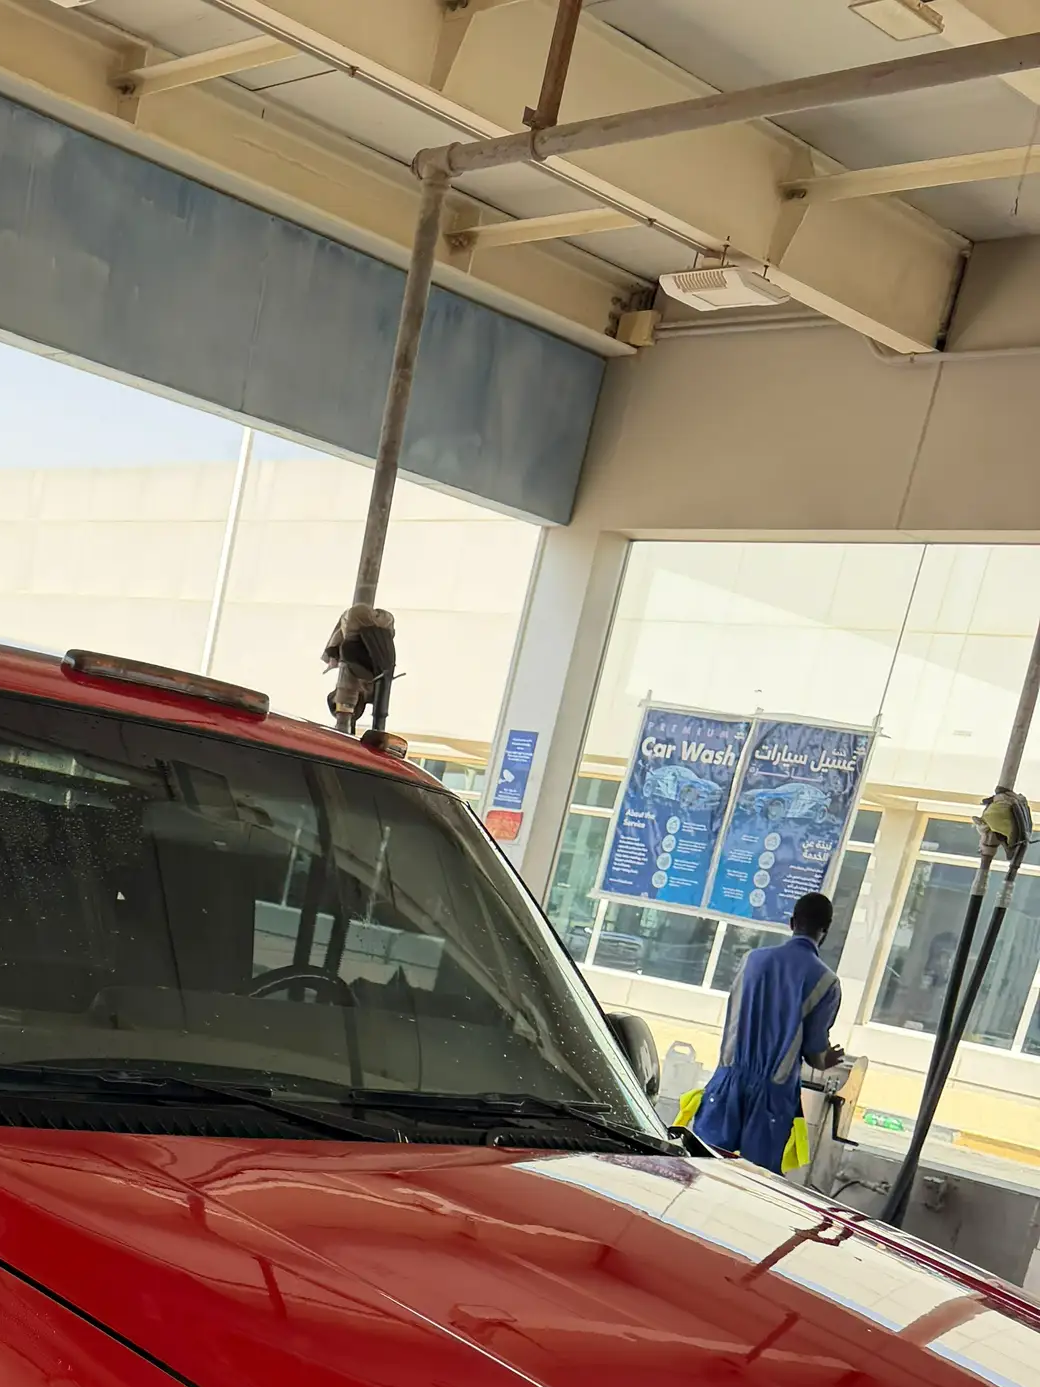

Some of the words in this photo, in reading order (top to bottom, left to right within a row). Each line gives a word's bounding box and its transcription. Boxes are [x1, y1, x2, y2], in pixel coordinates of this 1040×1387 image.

[647, 721, 729, 739] PREMIUM
[641, 736, 676, 759] Car
[681, 740, 736, 767] Wash
[754, 743, 808, 766] سيارات
[810, 750, 857, 773] غسيل
[623, 818, 646, 829] Service
